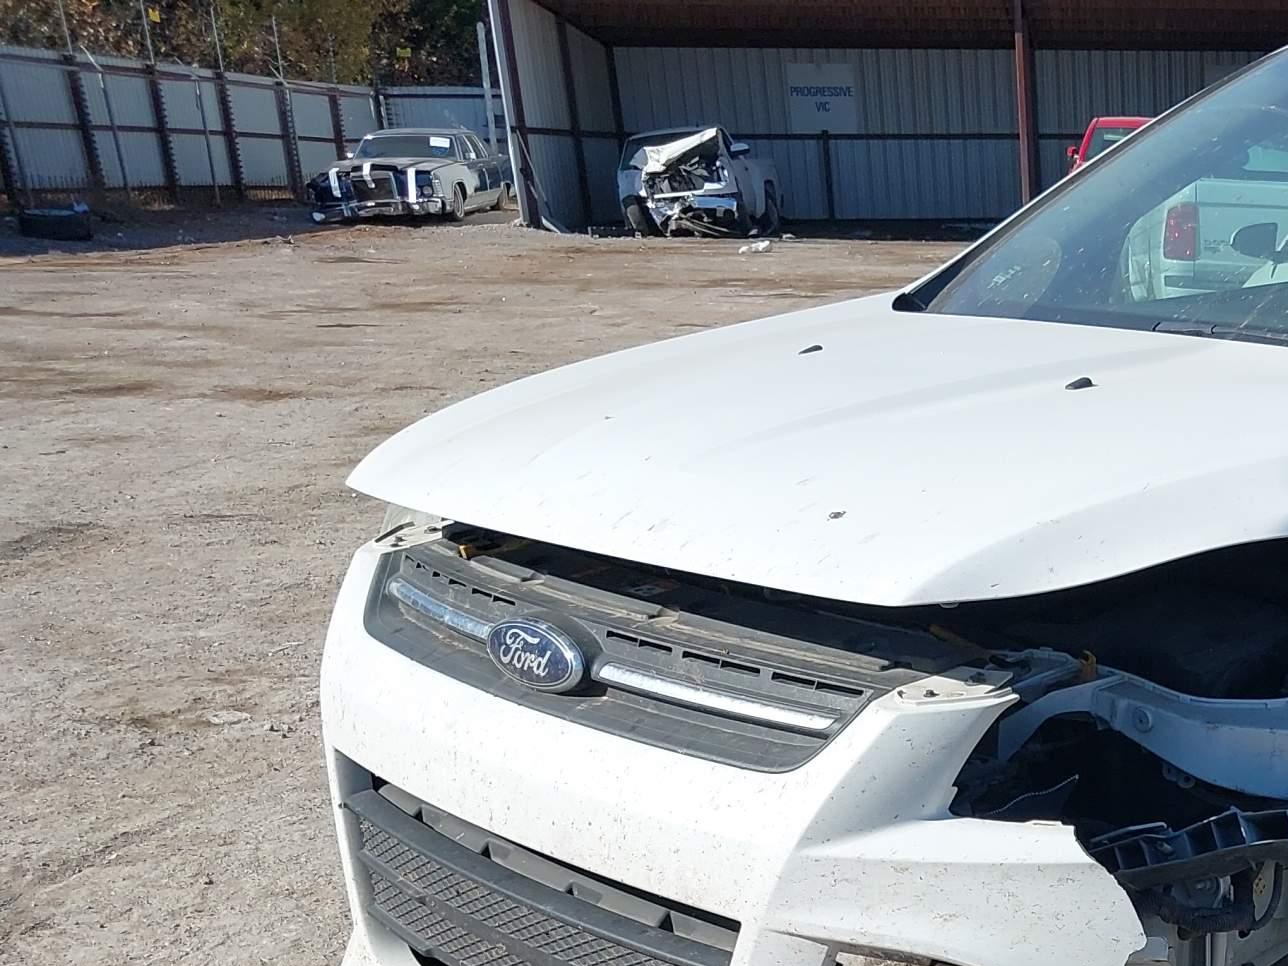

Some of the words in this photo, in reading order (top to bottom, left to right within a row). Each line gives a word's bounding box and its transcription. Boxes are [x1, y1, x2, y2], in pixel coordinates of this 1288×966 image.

[789, 86, 854, 97] PROGRESSIVE
[815, 101, 831, 113] VIC
[500, 628, 552, 676] Ford
